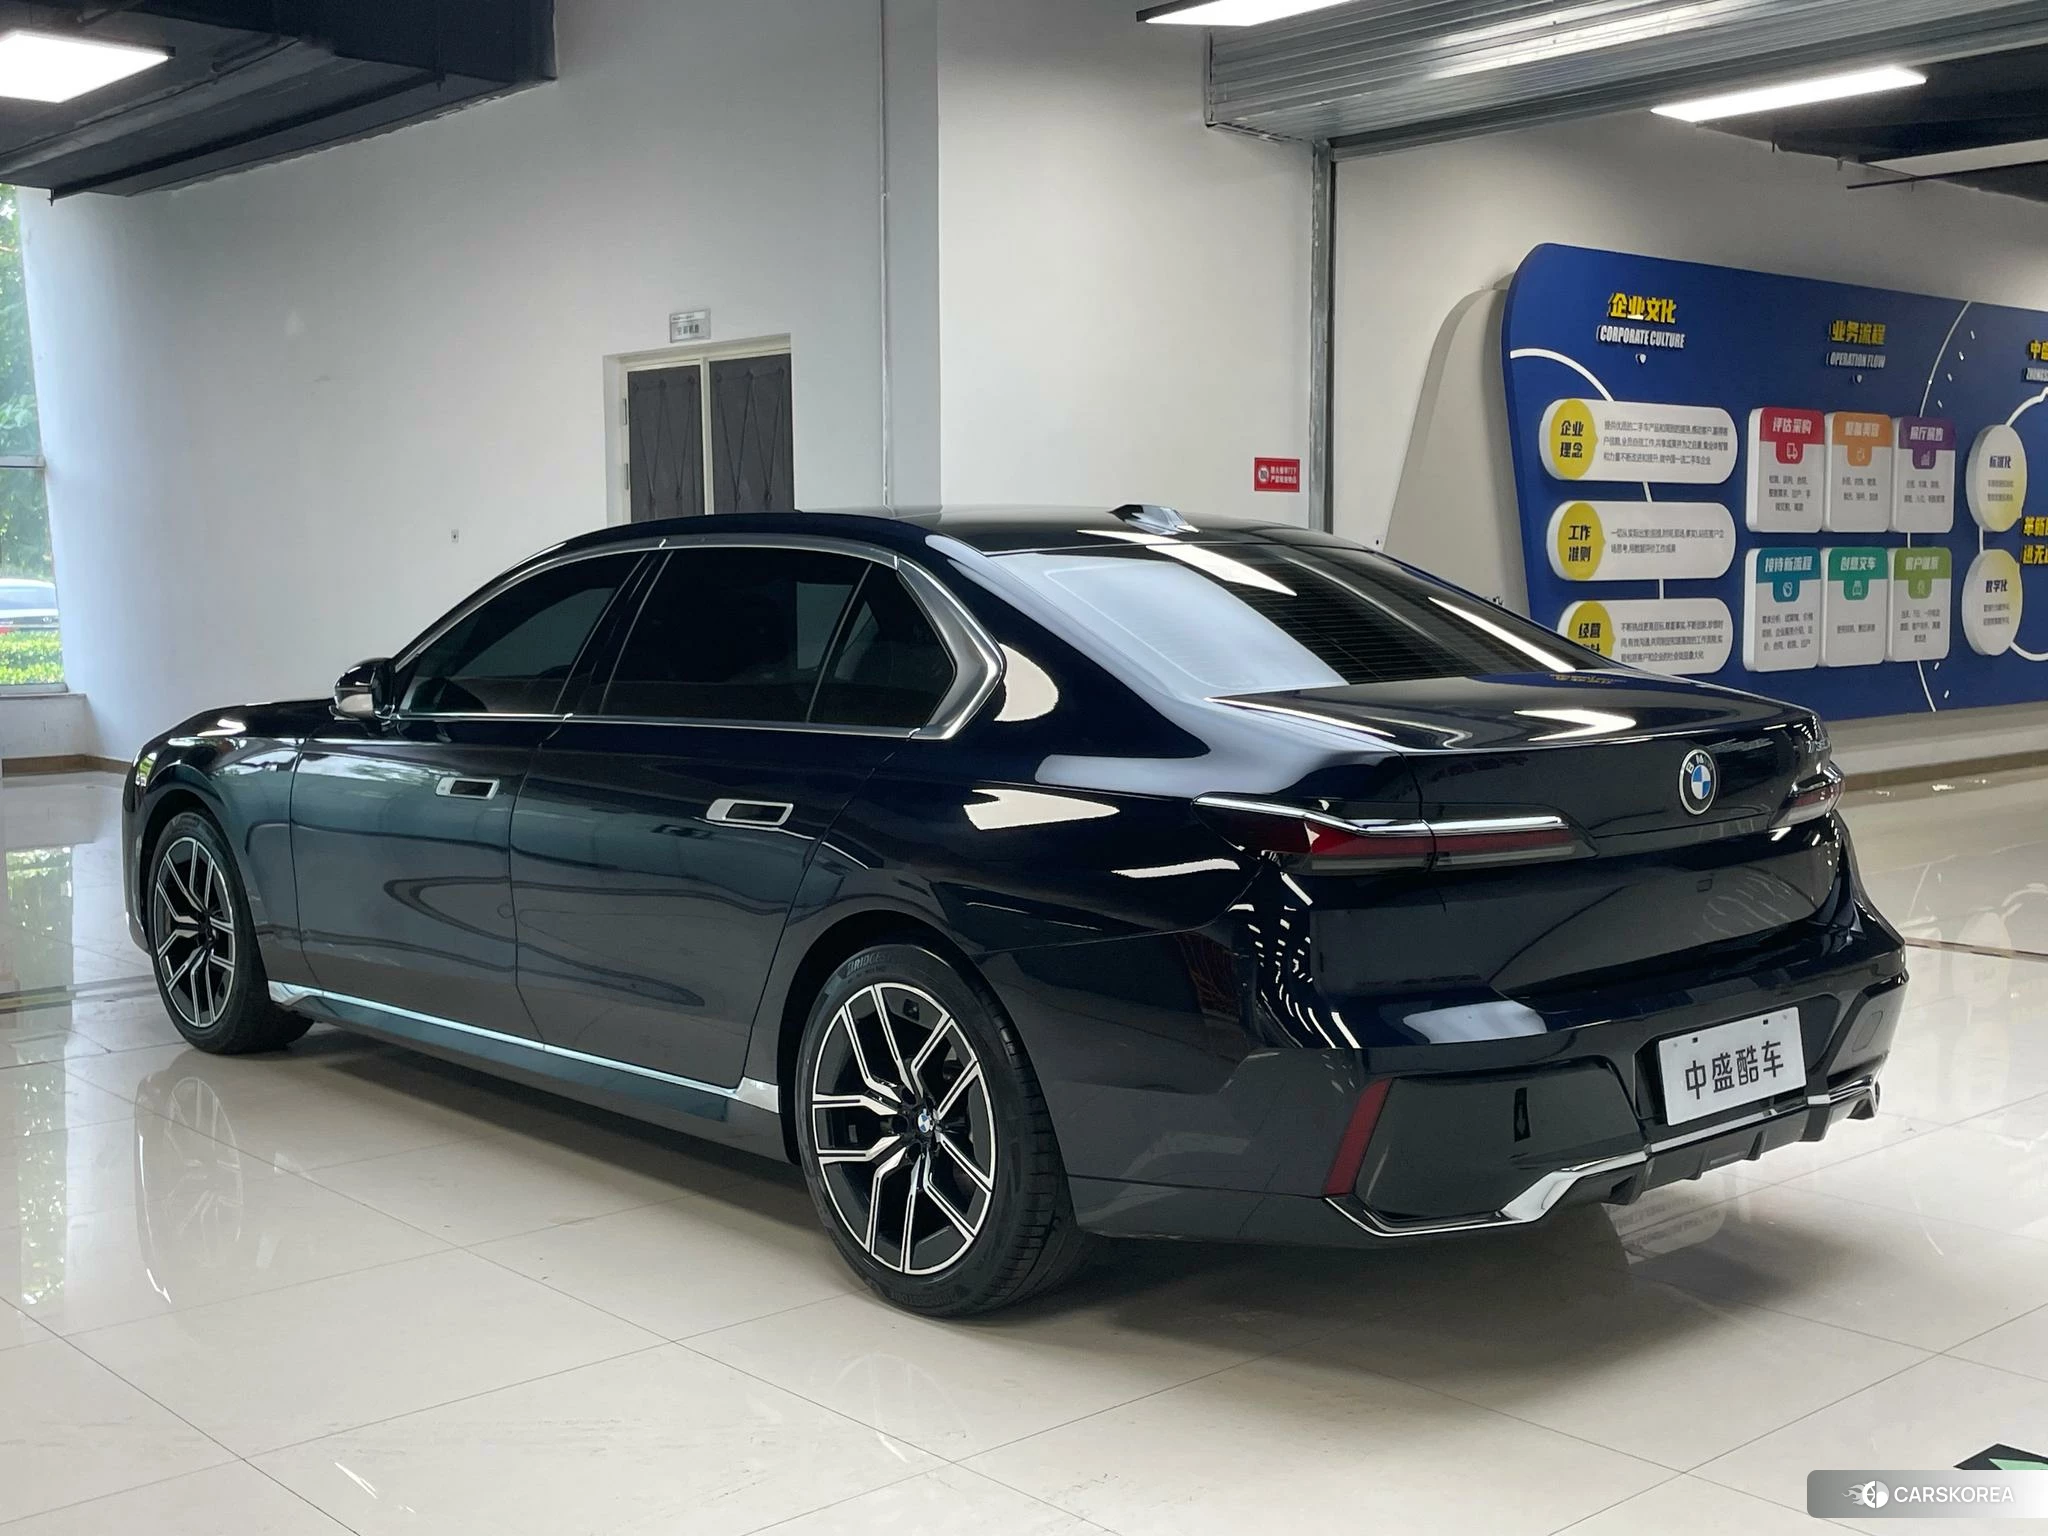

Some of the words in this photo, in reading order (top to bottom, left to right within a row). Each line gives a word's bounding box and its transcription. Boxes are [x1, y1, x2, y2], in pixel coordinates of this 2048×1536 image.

[1610, 292, 1676, 323] 企业文化
[1600, 325, 1649, 345] CORPORATE
[1650, 331, 1685, 348] CULTURE
[1831, 320, 1886, 344] 业务流程
[1830, 352, 1866, 367] OPERATION
[1867, 354, 1886, 368] FLOW
[1560, 420, 1584, 436] 企业
[1560, 442, 1583, 458] 理念
[1568, 524, 1591, 541] 工作
[1568, 545, 1591, 562] 准则
[1985, 579, 2008, 593] 数字化
[1578, 623, 1601, 638] 经营
[1684, 1040, 1784, 1100] 中盛酷车
